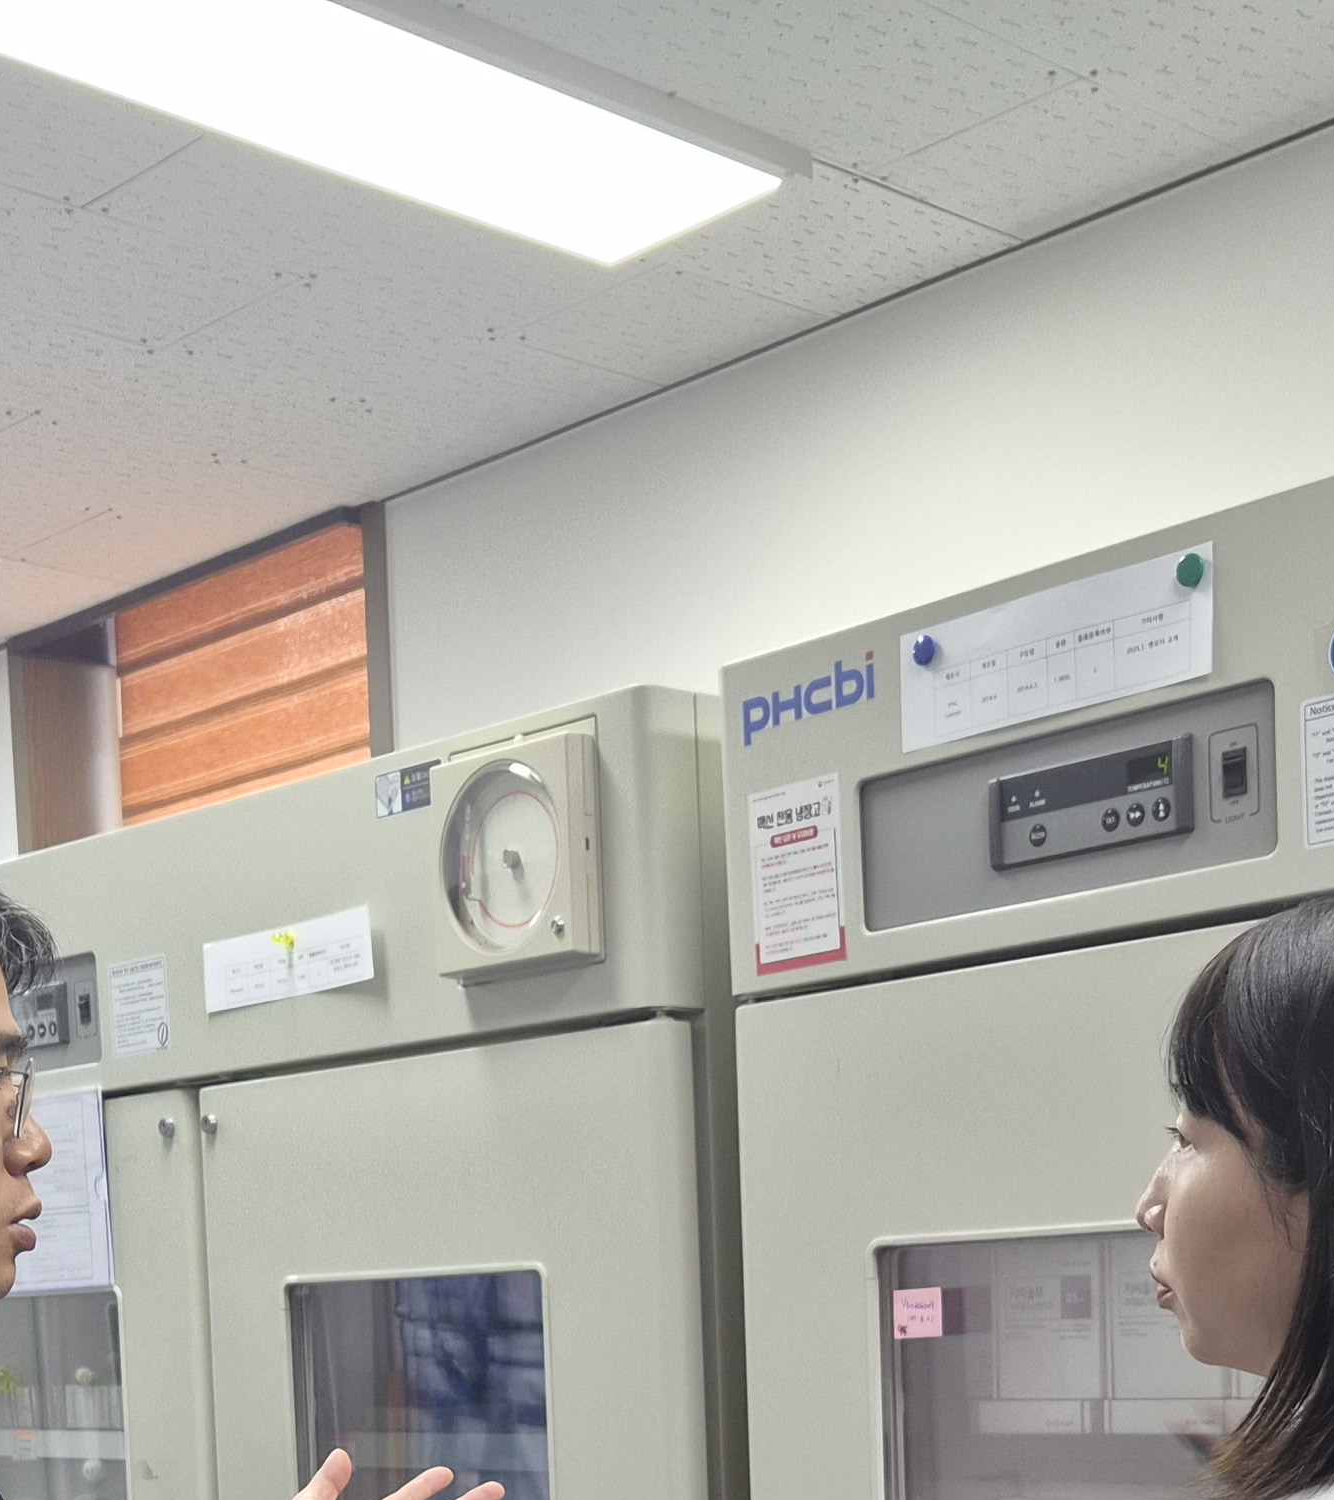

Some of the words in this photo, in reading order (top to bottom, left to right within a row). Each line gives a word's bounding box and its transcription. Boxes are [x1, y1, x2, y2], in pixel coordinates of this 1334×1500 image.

[1156, 755, 1170, 775] 4
[756, 813, 775, 830] 백신
[776, 808, 793, 827] 전용
[794, 801, 822, 823] 냉장고
